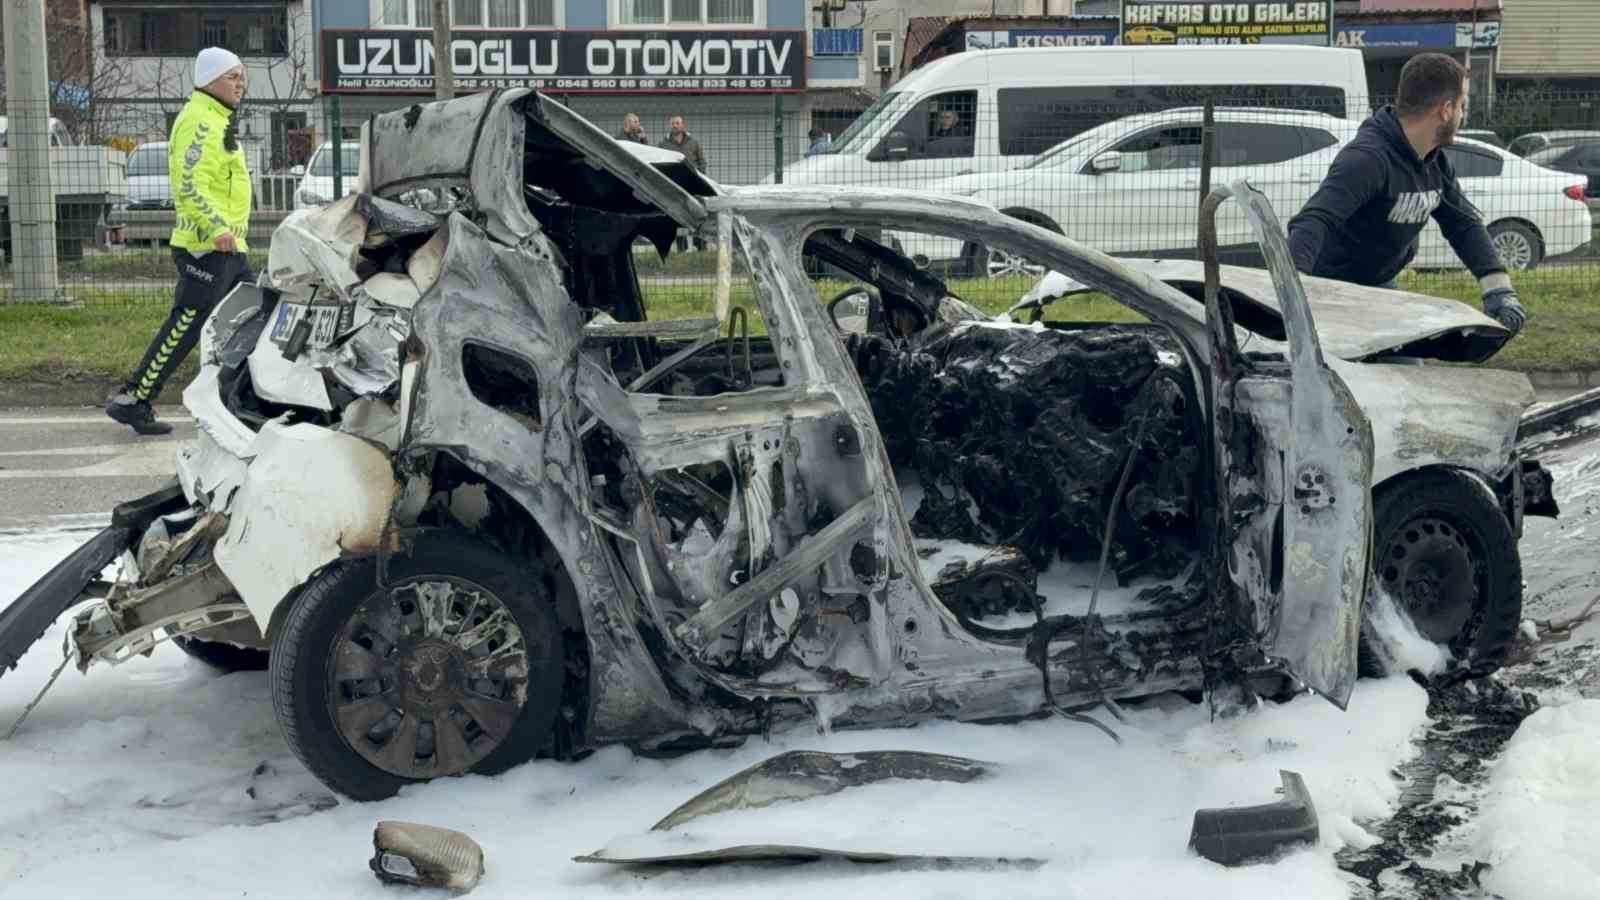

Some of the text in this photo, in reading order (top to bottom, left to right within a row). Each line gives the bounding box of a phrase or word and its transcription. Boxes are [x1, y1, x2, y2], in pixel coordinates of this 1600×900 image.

[1124, 4, 1204, 24] KAFKAS
[1209, 4, 1250, 24] OTO
[1015, 35, 1106, 47] KISMET
